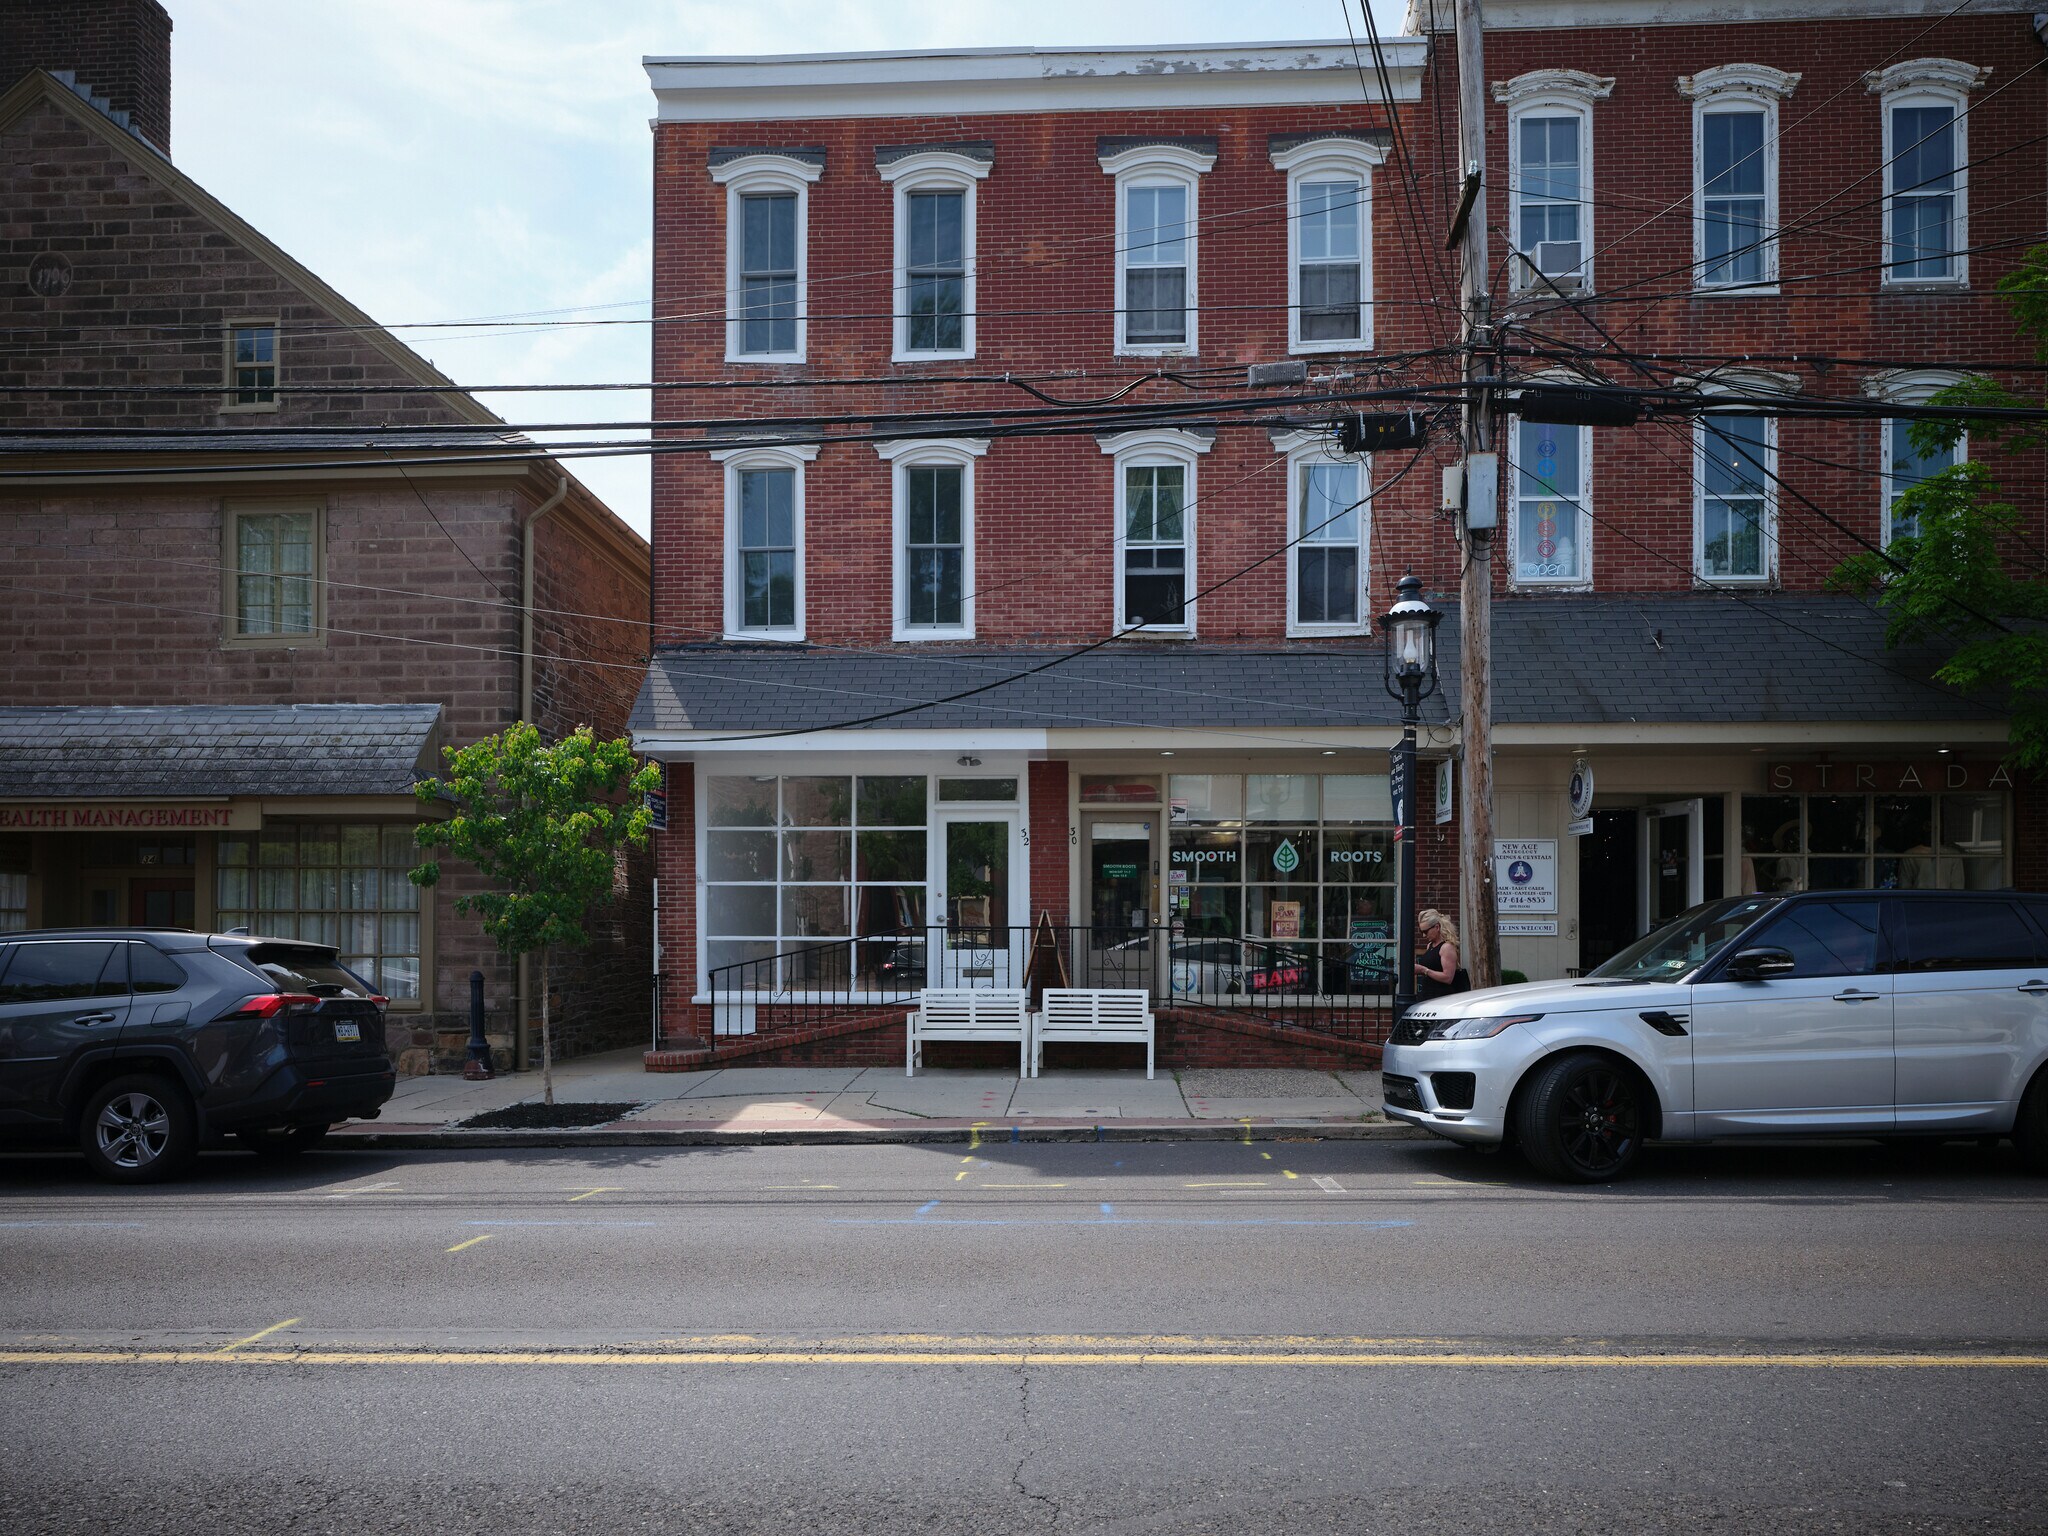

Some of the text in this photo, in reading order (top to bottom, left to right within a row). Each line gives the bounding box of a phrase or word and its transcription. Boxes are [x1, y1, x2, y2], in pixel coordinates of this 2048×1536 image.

[1528, 563, 1567, 576] open
[1773, 764, 2013, 789] STRADA
[0, 808, 233, 826] EALTH MANAGEMENT
[1020, 828, 1030, 846] 32
[1069, 827, 1078, 845] 30
[1172, 851, 1236, 863] SMOOTH
[1330, 851, 1382, 863] ROOTS
[1276, 922, 1295, 931] OPEN
[1351, 932, 1387, 949] CBD
